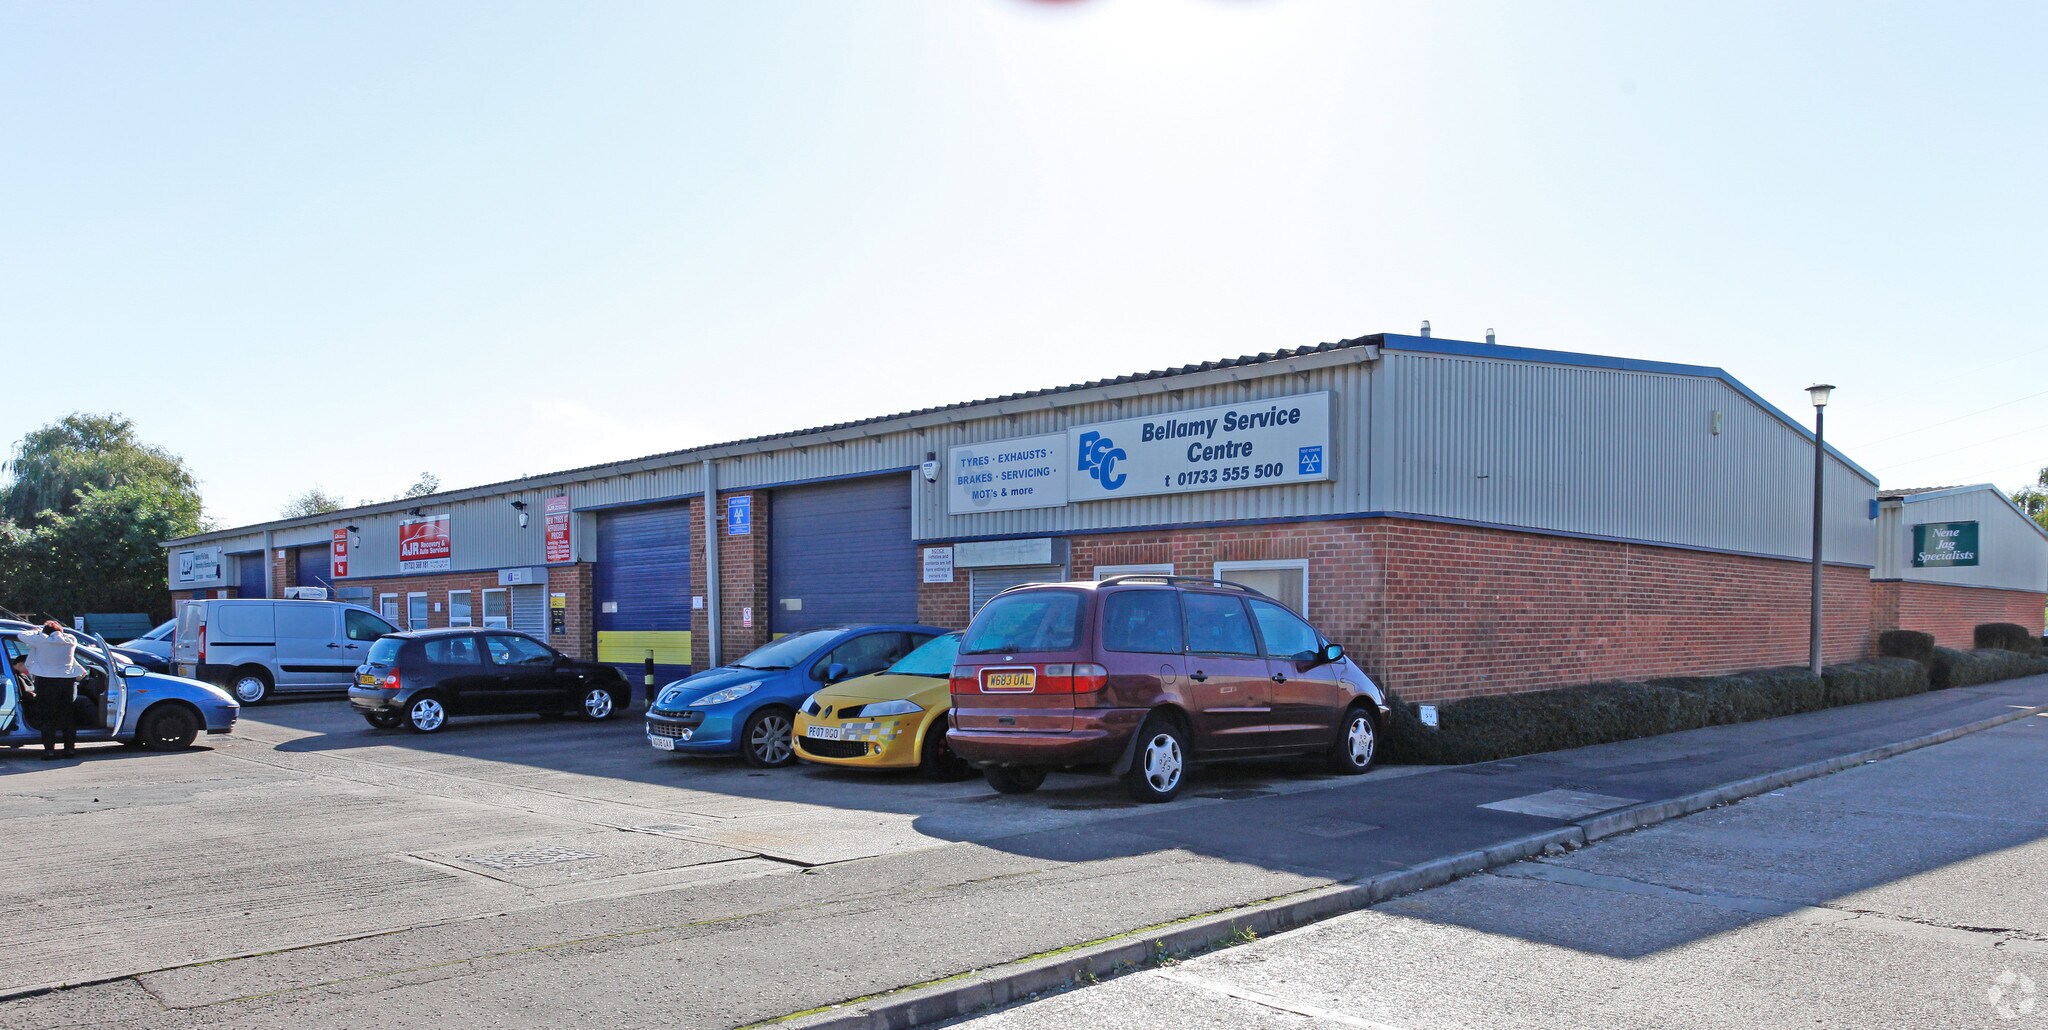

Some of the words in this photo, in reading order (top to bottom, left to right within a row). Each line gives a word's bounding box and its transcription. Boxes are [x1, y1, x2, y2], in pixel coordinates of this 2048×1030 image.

[1141, 418, 1217, 443] Bellamy
[1223, 406, 1301, 432] Service
[961, 456, 989, 467] TYRES
[998, 449, 1047, 463] EXHAUSTS
[1077, 430, 1128, 490] BSC
[1187, 441, 1253, 463] Centre
[957, 473, 993, 486] BRAKES
[1001, 467, 1050, 481] SERVICING
[1165, 475, 1171, 487] t
[1178, 469, 1218, 486] 01733
[1222, 465, 1250, 482] 555
[1254, 462, 1283, 479] 500
[972, 489, 998, 500] MOT's
[1001, 488, 1008, 497] &
[1011, 487, 1034, 496] more
[1932, 528, 1960, 538] Nene
[401, 542, 419, 556] AJR
[1936, 540, 1956, 550] Jag
[1917, 550, 1974, 563] Specialists
[1014, 674, 1031, 686] UAL
